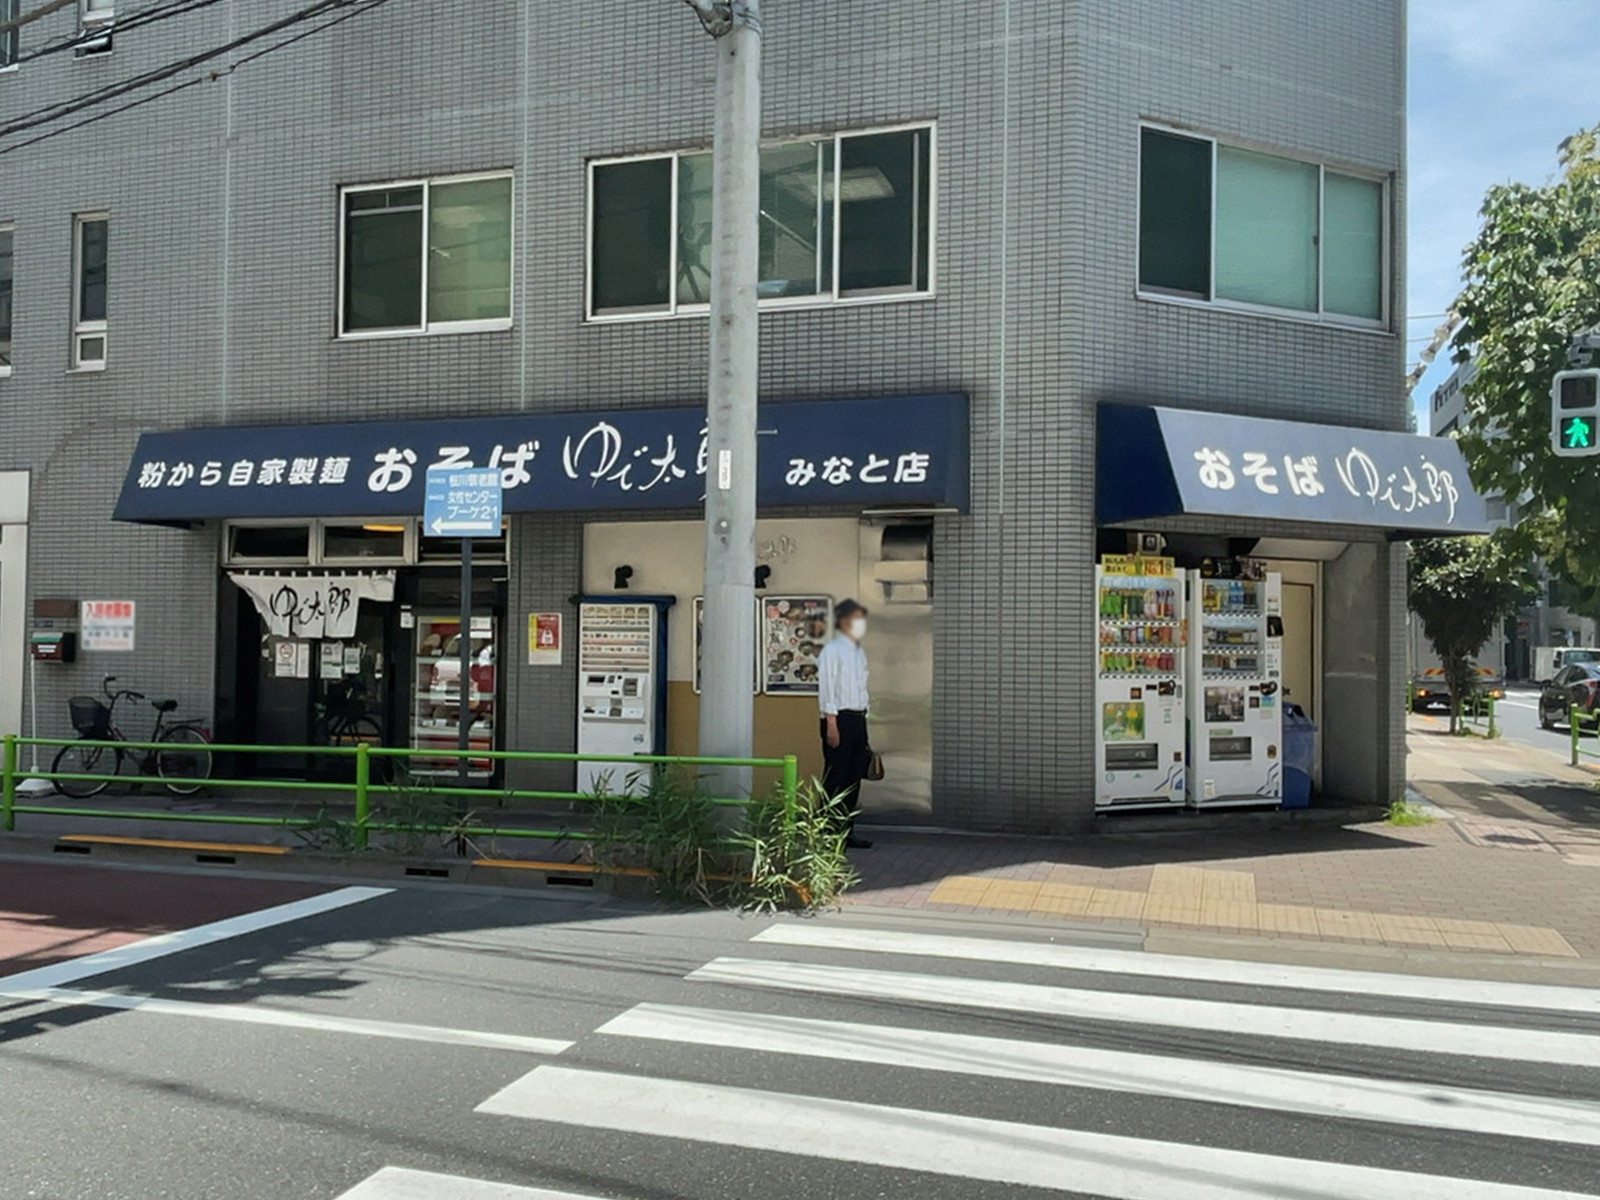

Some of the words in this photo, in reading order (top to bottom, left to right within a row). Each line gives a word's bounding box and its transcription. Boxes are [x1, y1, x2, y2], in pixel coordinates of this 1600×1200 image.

[137, 456, 351, 488] 粉から自家製麺
[785, 452, 930, 486] みなと店
[1193, 446, 1325, 497] おそば
[1335, 446, 1459, 524] ゆで太郎
